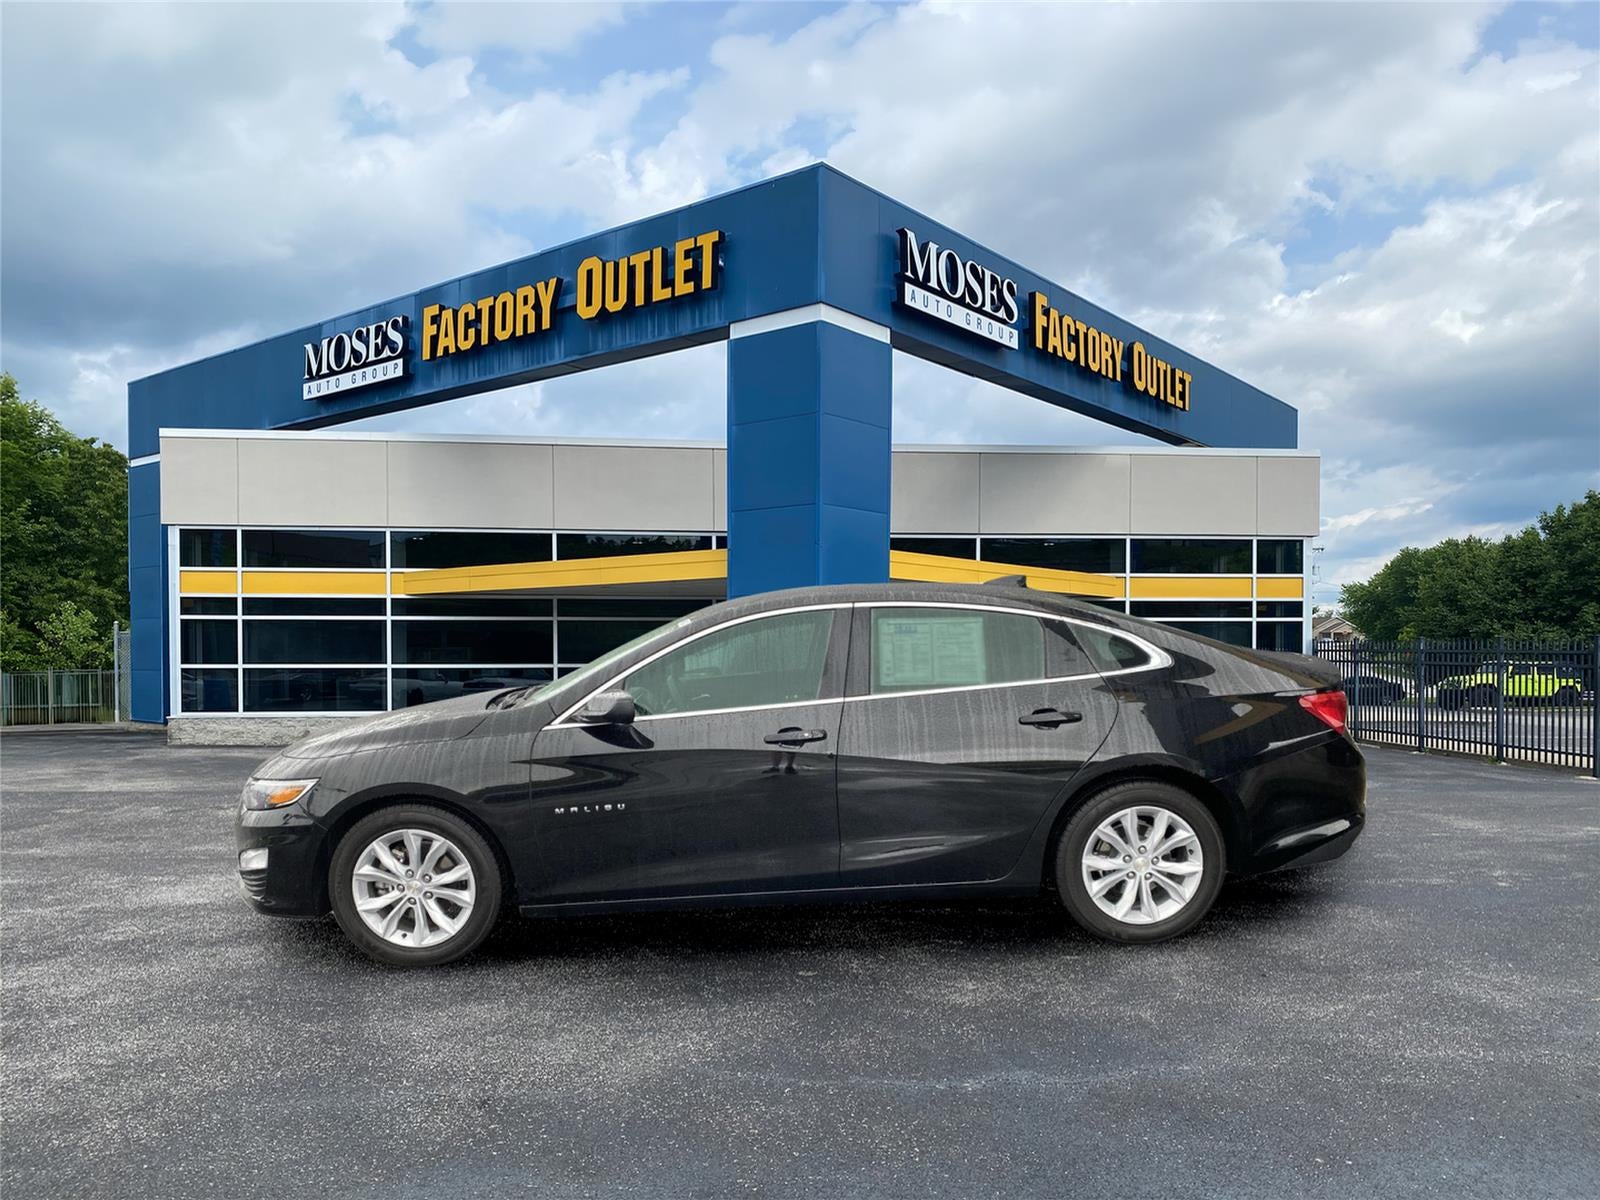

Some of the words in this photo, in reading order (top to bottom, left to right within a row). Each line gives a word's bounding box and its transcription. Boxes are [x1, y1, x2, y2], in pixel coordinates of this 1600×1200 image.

[421, 276, 560, 361] FACTORY
[576, 229, 720, 321] OUTLET
[904, 227, 1019, 324] MOSES
[303, 315, 406, 379] MOSES
[910, 288, 952, 318] AUTO
[965, 312, 1015, 343] GROUP
[306, 379, 341, 396] AUTO
[350, 363, 400, 385] GROUP
[1034, 290, 1124, 382] FACTORY
[1131, 340, 1193, 411] OUTLET
[554, 803, 626, 815] MALIBU
